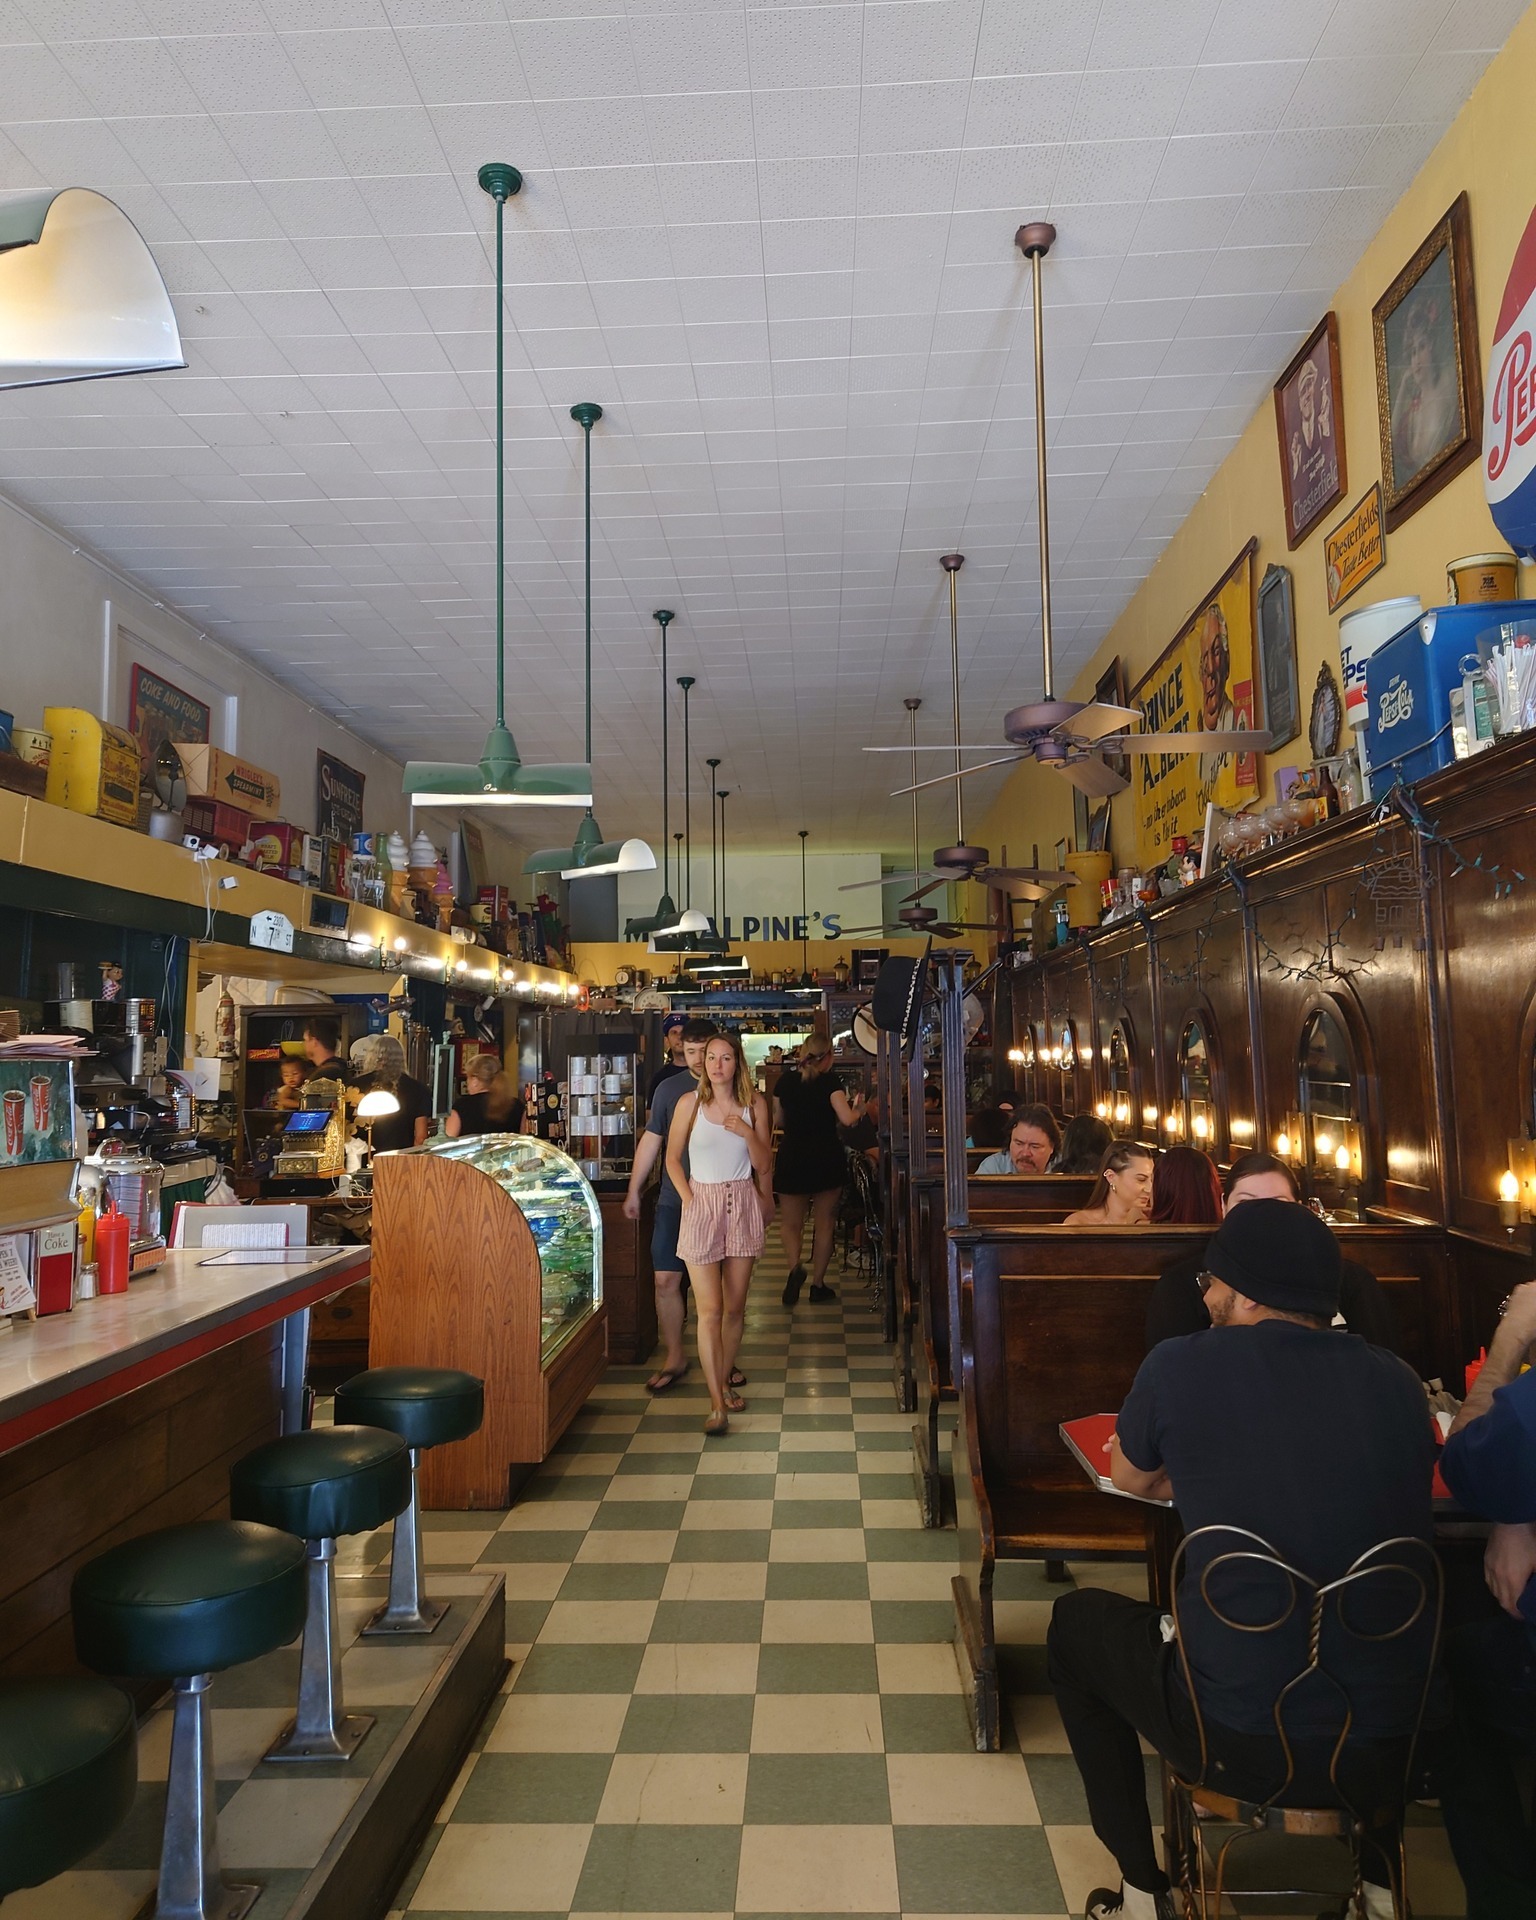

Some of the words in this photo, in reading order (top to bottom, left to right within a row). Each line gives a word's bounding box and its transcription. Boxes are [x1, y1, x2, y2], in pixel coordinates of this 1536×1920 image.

[1292, 456, 1339, 530] Chesterfield
[1327, 503, 1379, 566] Chesterfields
[140, 678, 164, 700] COKE
[163, 691, 181, 711] AND
[180, 700, 201, 722] FOOD
[233, 779, 262, 796] SPEARMINT
[251, 925, 257, 939] N
[44, 1237, 69, 1251] Coke
